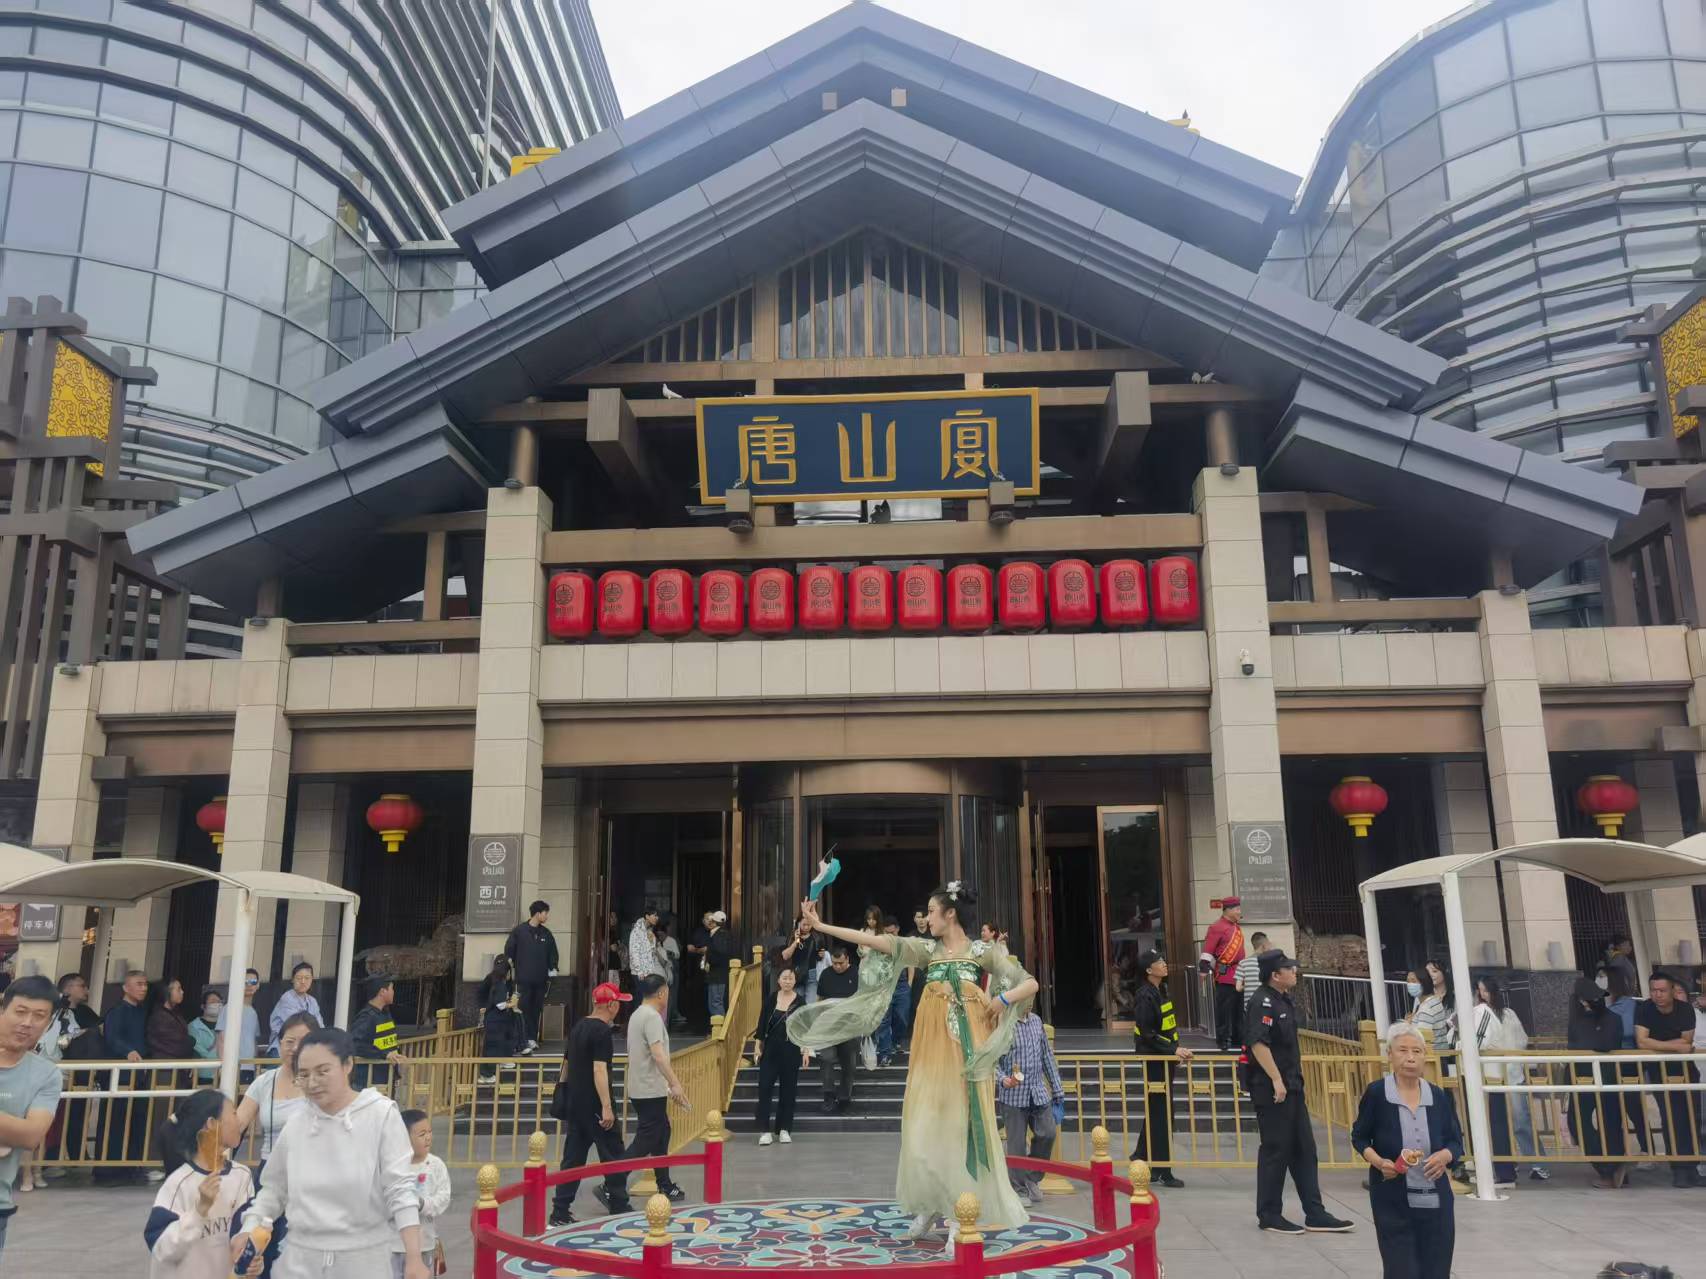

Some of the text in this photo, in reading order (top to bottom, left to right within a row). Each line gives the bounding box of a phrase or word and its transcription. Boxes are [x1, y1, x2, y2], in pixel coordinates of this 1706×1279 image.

[738, 409, 1001, 484] 唐山宴
[479, 885, 506, 899] 西门
